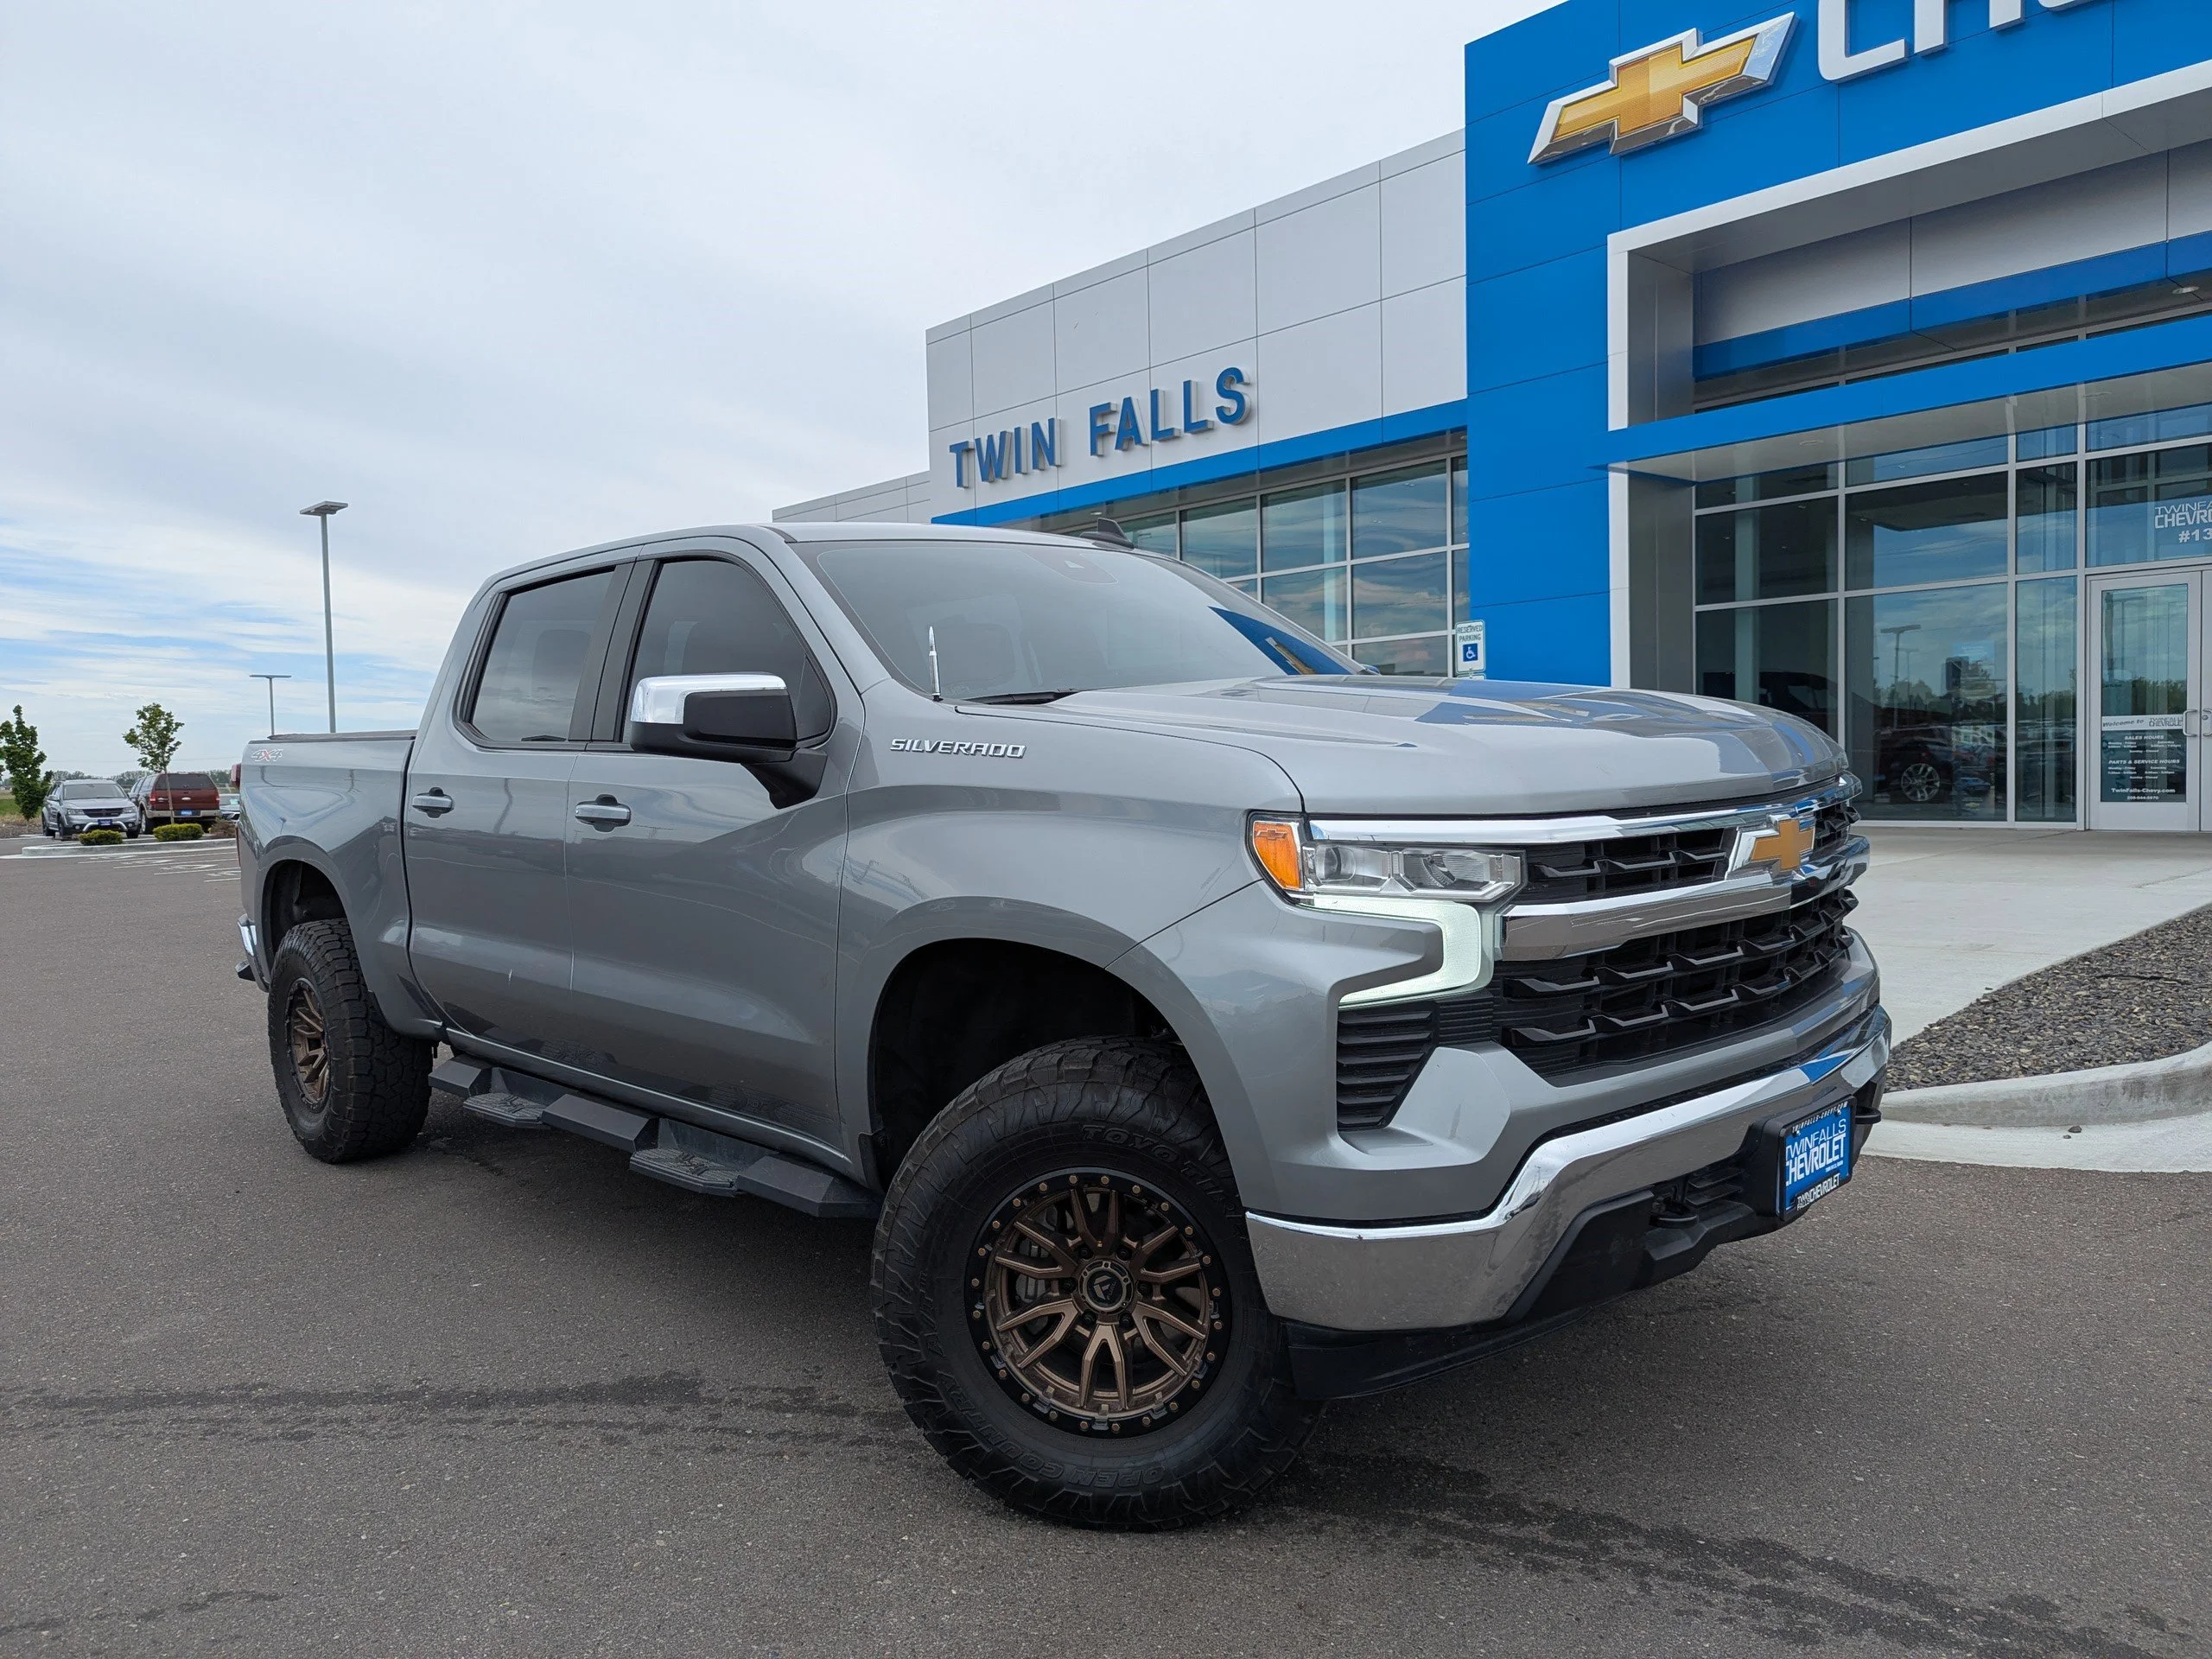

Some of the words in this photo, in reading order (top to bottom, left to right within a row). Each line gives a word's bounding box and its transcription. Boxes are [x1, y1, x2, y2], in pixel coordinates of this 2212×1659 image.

[950, 418, 1062, 488] TWIN
[1090, 367, 1251, 457] FALLS
[1458, 625, 1482, 633] RESERVED
[890, 738, 1027, 759] SILVERADO
[1081, 1124, 1180, 1163] TOYO
